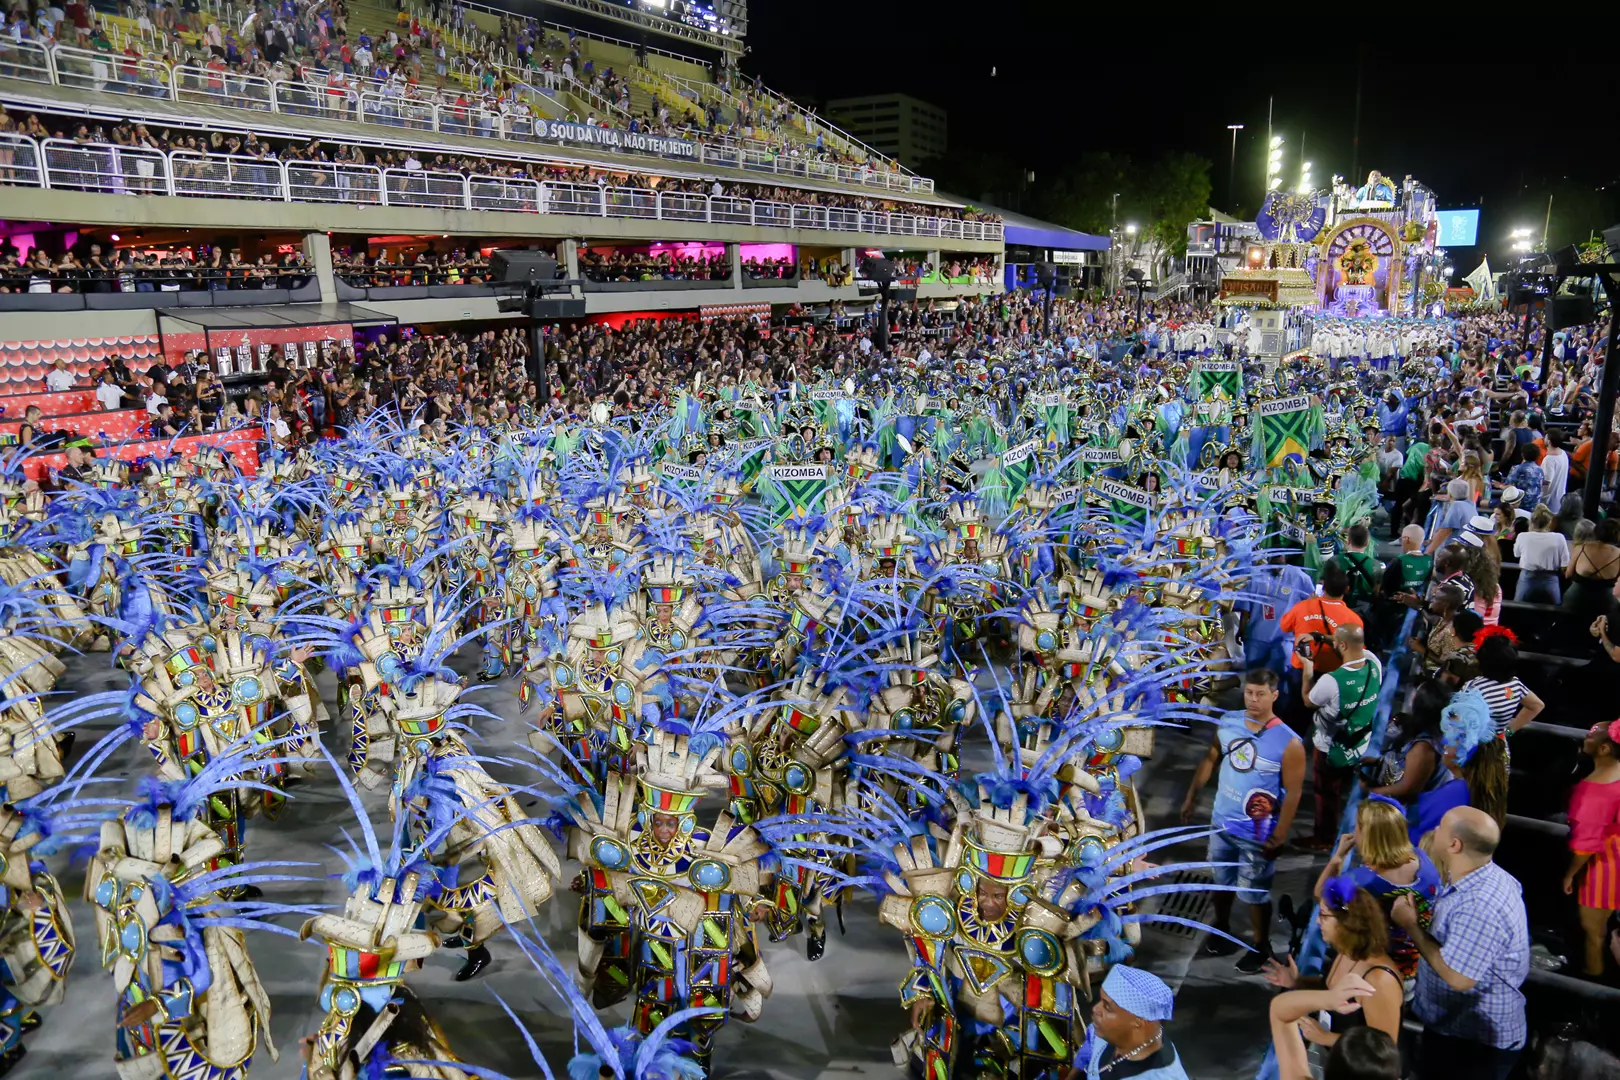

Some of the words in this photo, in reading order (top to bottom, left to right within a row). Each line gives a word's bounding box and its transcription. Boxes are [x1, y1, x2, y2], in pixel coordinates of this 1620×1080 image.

[550, 123, 574, 140] SOU
[576, 127, 593, 143] DA
[596, 129, 622, 148] VILA,
[624, 132, 646, 150] NÃO
[648, 138, 667, 153] TEM
[668, 139, 693, 156] JEITO
[1261, 398, 1308, 414] KIZOMBA
[1085, 451, 1121, 460] KIZOMB
[774, 467, 824, 478] KIZOMBA
[1103, 482, 1152, 507] KIZOMBA
[1273, 489, 1312, 503] KIZMB
